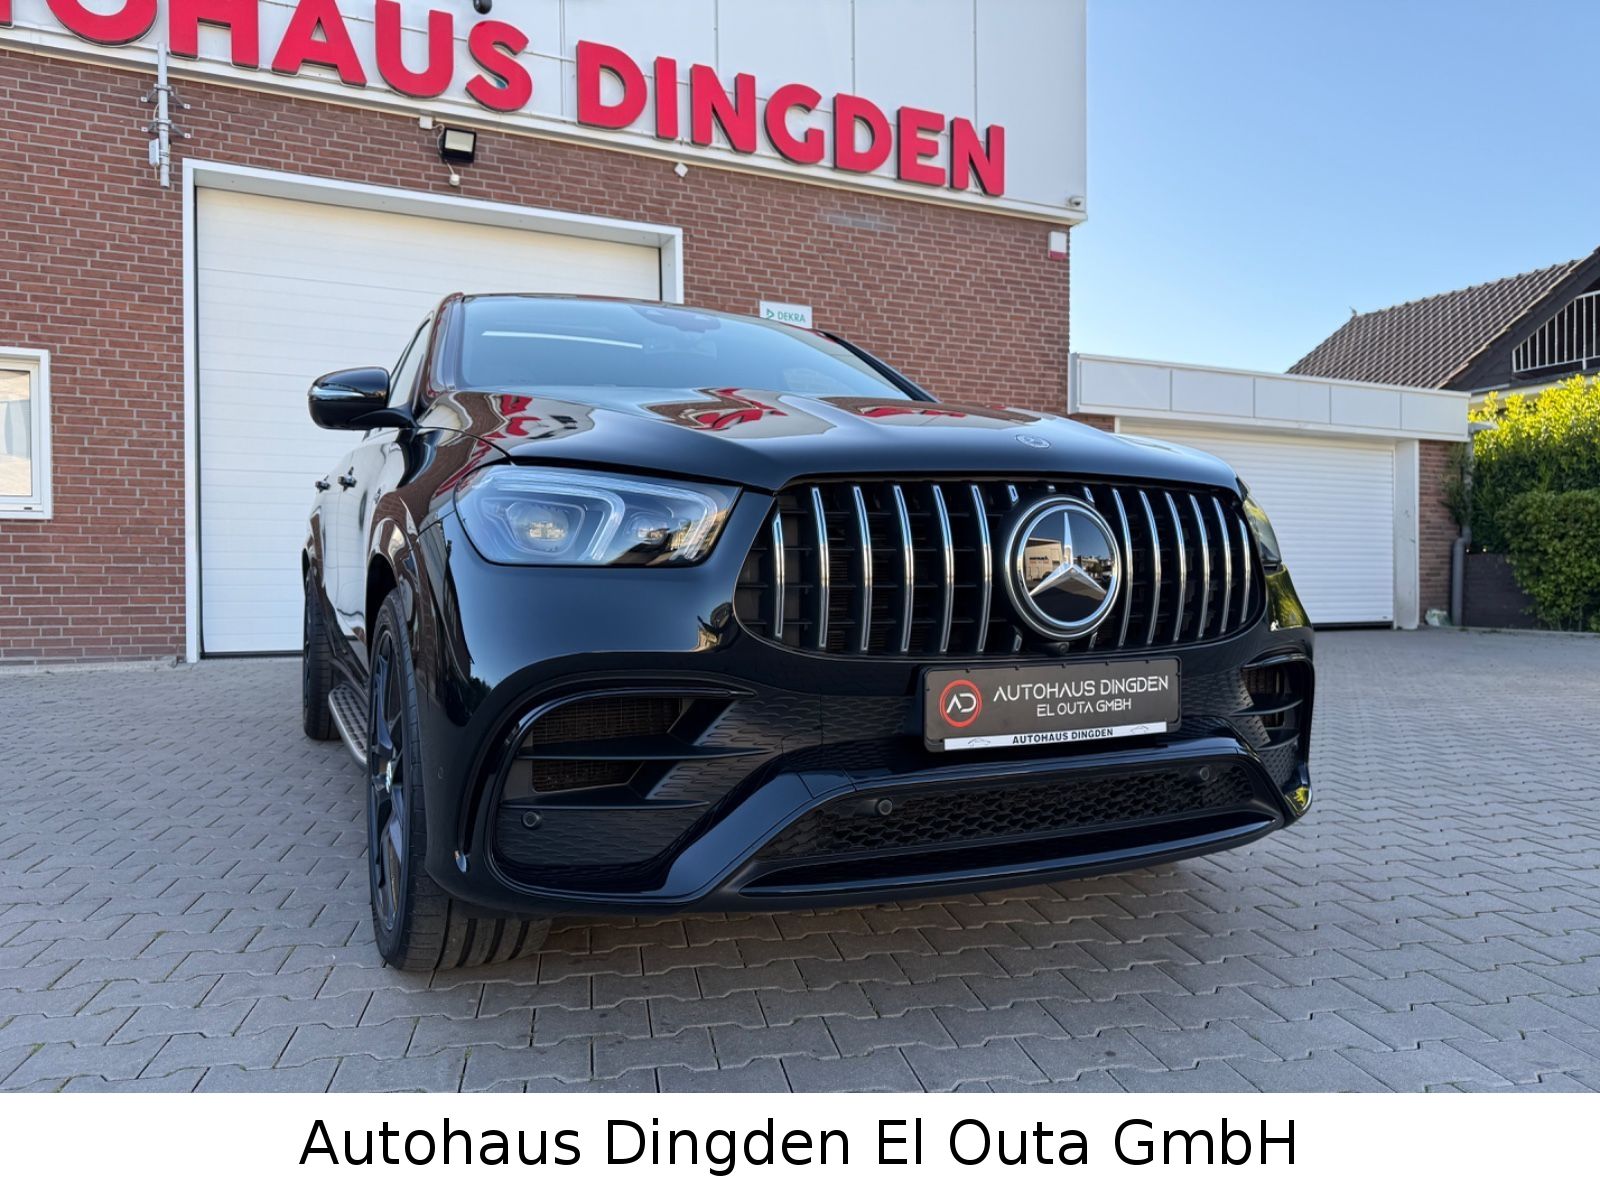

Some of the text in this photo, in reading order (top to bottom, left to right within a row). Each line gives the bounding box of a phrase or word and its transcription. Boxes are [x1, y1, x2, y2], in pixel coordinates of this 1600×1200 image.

[576, 40, 1004, 196] DINGDEN
[777, 311, 805, 322] DEKRA
[993, 675, 1168, 702] AUTOHAUS DINGDEN
[1036, 698, 1132, 717] EL OUTA GMBH
[1012, 728, 1114, 745] AUTOHAUS DINGDEN
